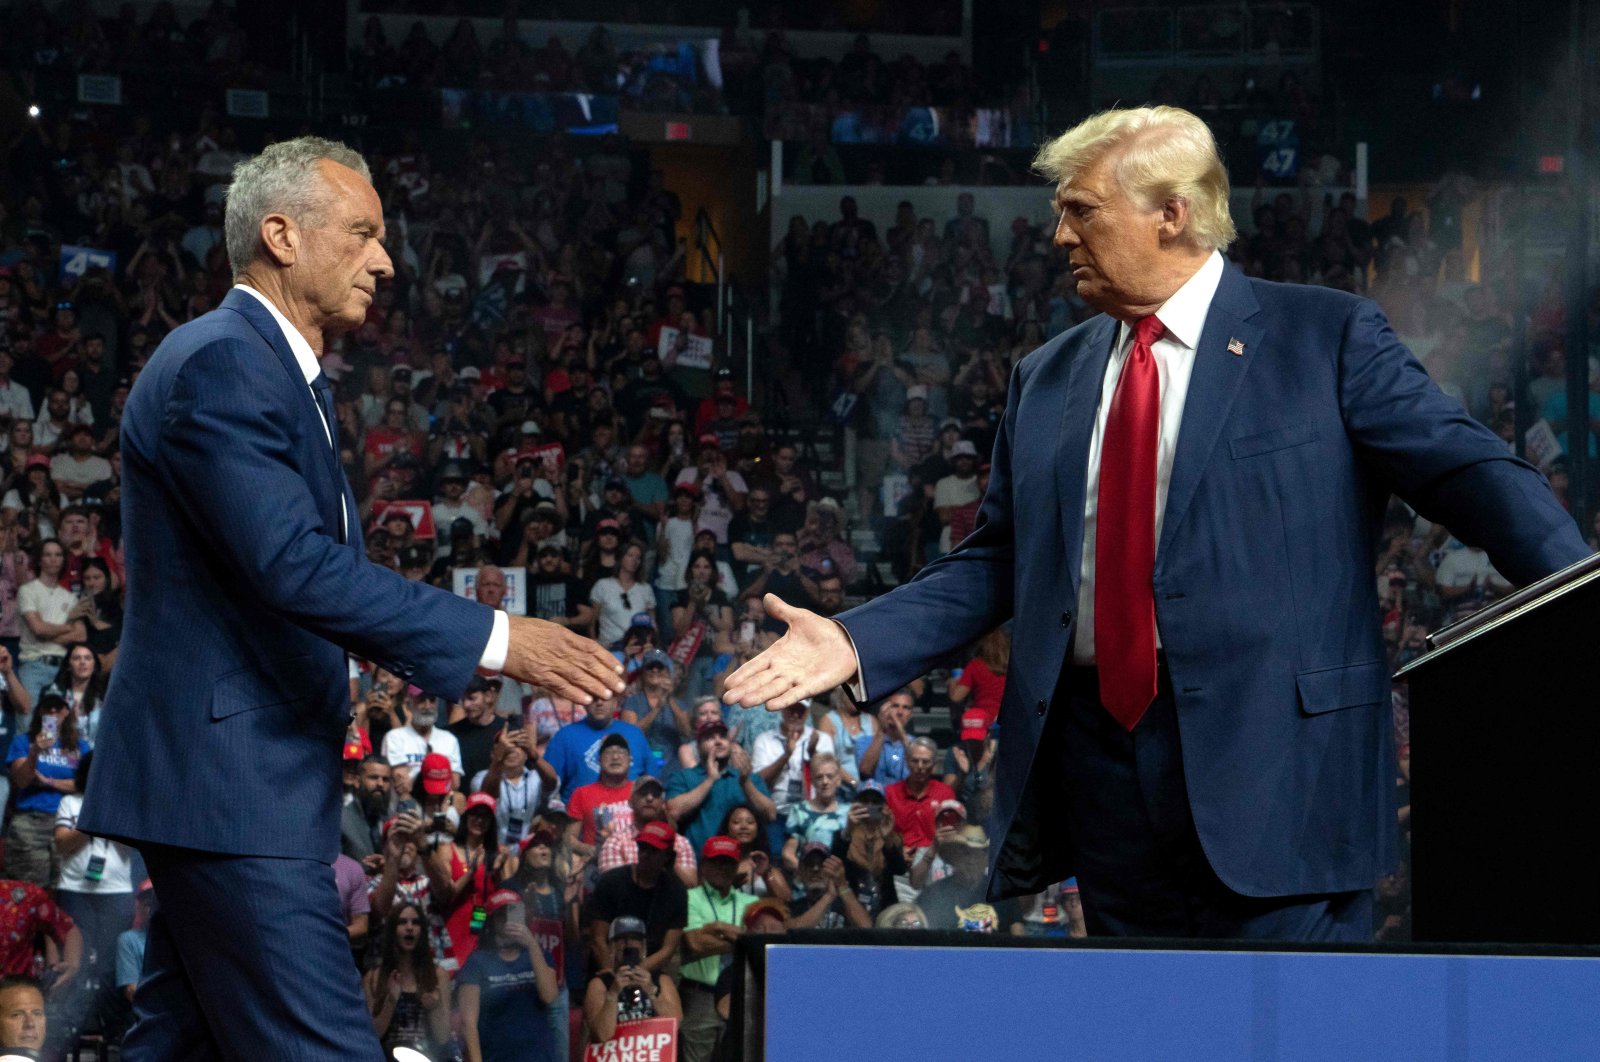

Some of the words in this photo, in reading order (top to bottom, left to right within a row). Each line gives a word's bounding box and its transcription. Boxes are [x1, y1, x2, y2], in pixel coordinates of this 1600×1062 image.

[1262, 149, 1296, 172] 47
[591, 1033, 672, 1057] TRUMP
[597, 1050, 661, 1062] VANCE
